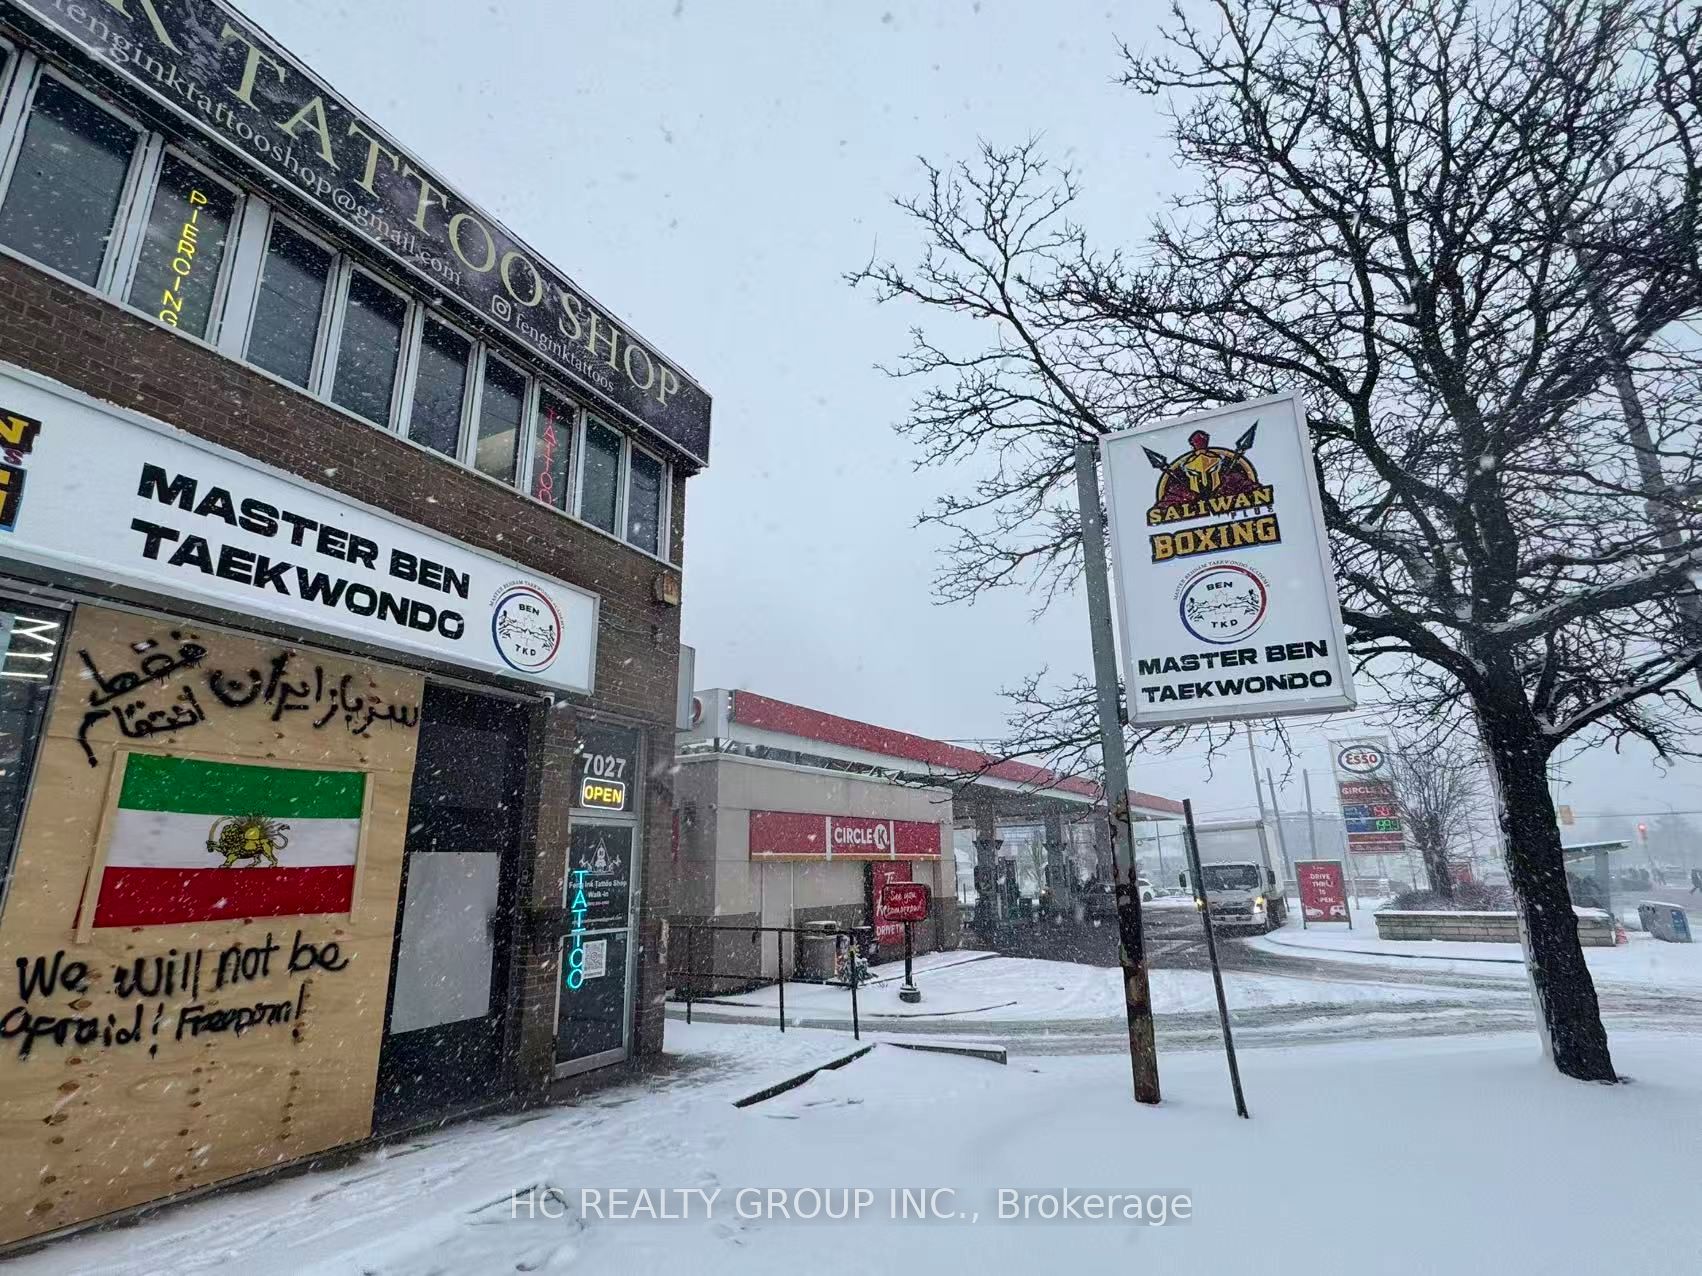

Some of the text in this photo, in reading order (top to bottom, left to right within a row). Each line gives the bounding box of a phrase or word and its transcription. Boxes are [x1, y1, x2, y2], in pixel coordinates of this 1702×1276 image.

[220, 22, 681, 407] TATTOO SHOP
[160, 189, 208, 328] PIERCING
[1149, 487, 1273, 524] SALIWAN
[137, 462, 470, 599] MASTER BEN
[1154, 517, 1278, 560] BOXING
[130, 517, 465, 640] TAEKWONDO
[1206, 581, 1233, 591] BEN
[518, 604, 540, 615] BEN
[1211, 619, 1238, 628] TKD
[515, 644, 537, 656] TKD
[1138, 639, 1329, 676] MASTER BEN
[1142, 669, 1333, 703] TAEKWONDO
[582, 752, 626, 778] 7027
[584, 785, 622, 803] OPEN
[834, 826, 888, 849] CIRCLE K
[568, 870, 588, 989] TATTOO
[16, 929, 350, 1004] We will not be
